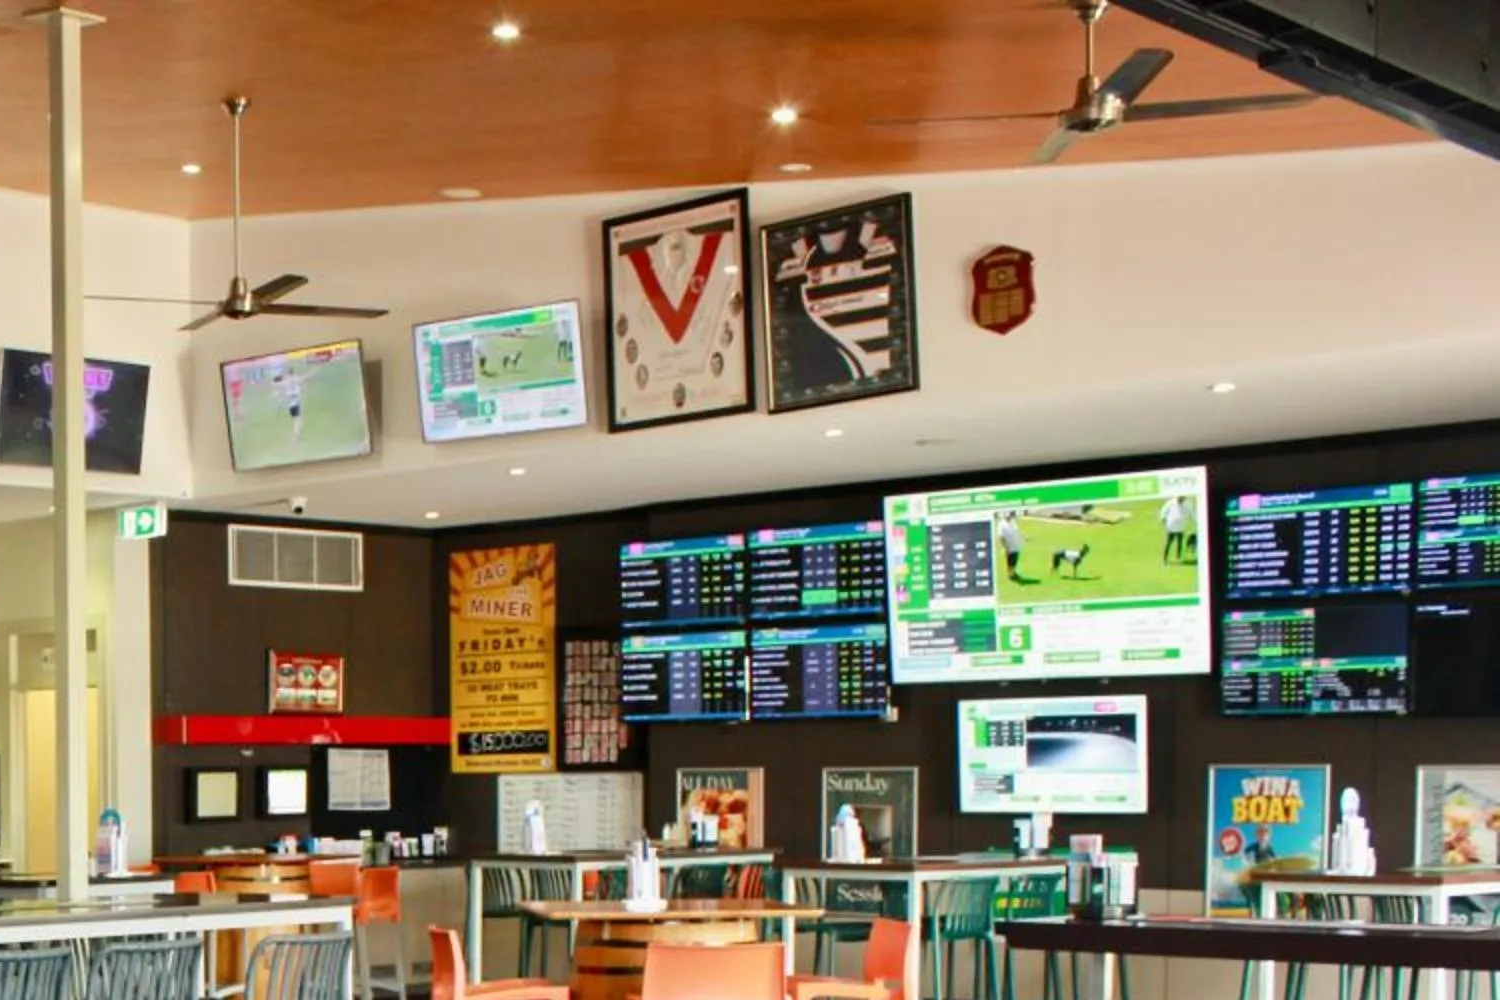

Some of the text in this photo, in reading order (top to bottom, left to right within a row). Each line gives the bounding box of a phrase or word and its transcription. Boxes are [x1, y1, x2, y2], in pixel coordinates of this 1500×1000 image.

[474, 563, 507, 586] JAG
[470, 599, 533, 617] MINER
[460, 661, 501, 675] $2.00
[827, 772, 888, 794] Sunday
[1241, 776, 1287, 797] WIN
[1231, 796, 1304, 824] BOAT
